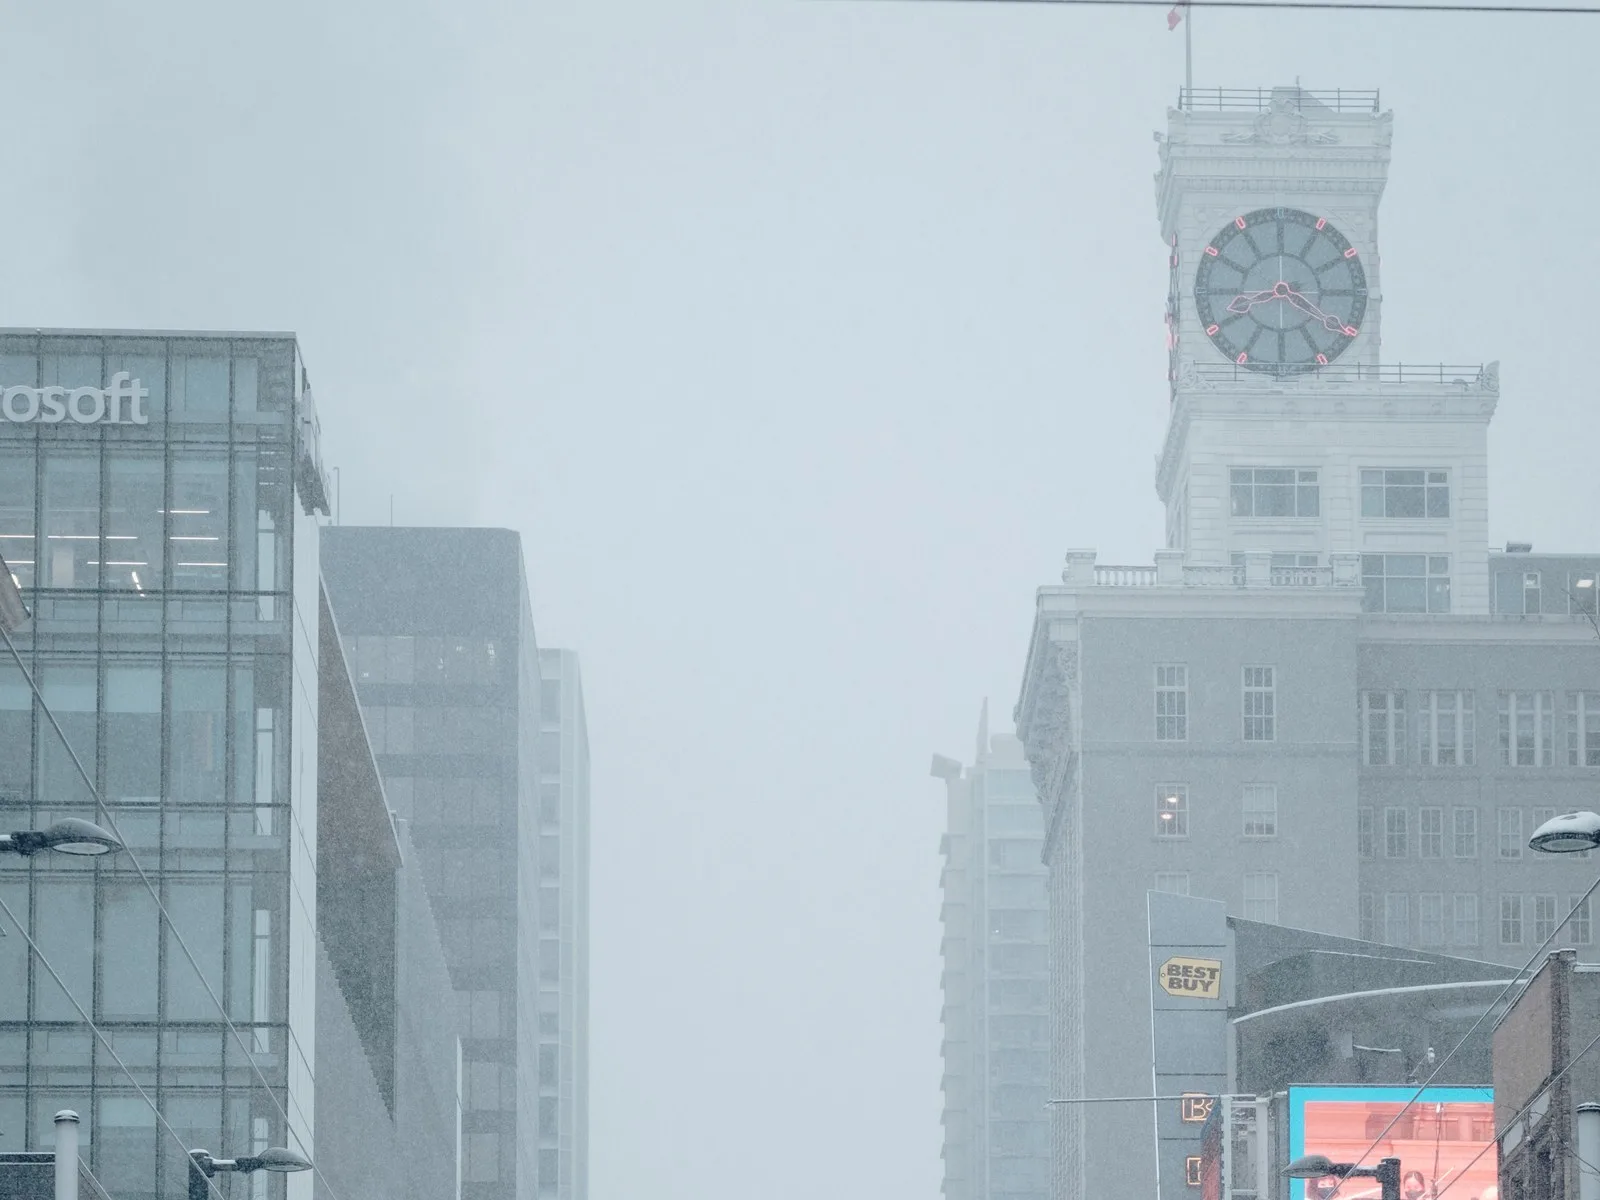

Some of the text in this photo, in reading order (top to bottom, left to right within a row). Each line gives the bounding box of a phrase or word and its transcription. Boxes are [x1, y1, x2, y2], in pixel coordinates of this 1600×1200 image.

[0, 371, 148, 424] osoft
[1167, 964, 1219, 980] BEST
[1168, 977, 1214, 992] BUY
